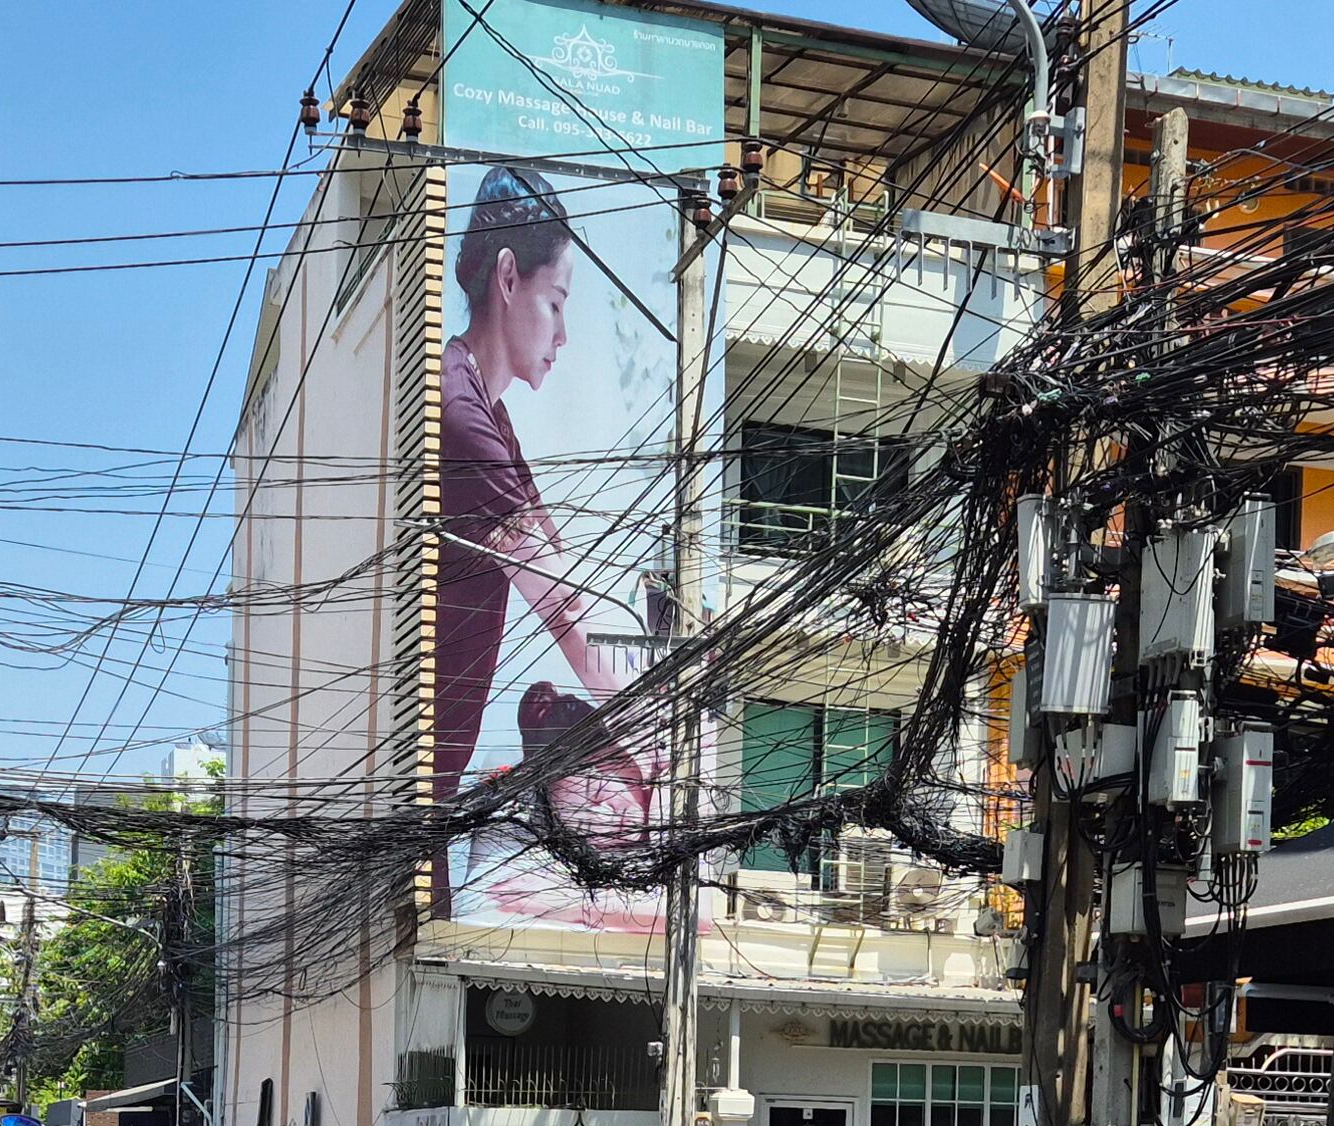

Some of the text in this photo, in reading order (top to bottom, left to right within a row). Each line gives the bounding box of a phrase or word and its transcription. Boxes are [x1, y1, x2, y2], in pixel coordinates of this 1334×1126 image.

[586, 83, 620, 95] NUAD
[453, 82, 493, 105] Cozy
[498, 90, 570, 116] Massage
[632, 111, 645, 126] &
[650, 113, 681, 131] Nail
[686, 119, 712, 136] Bar
[518, 115, 549, 131] Call.
[829, 1019, 933, 1050] MASSAGE
[936, 1026, 952, 1052] &
[958, 1026, 1001, 1052] NAIL
